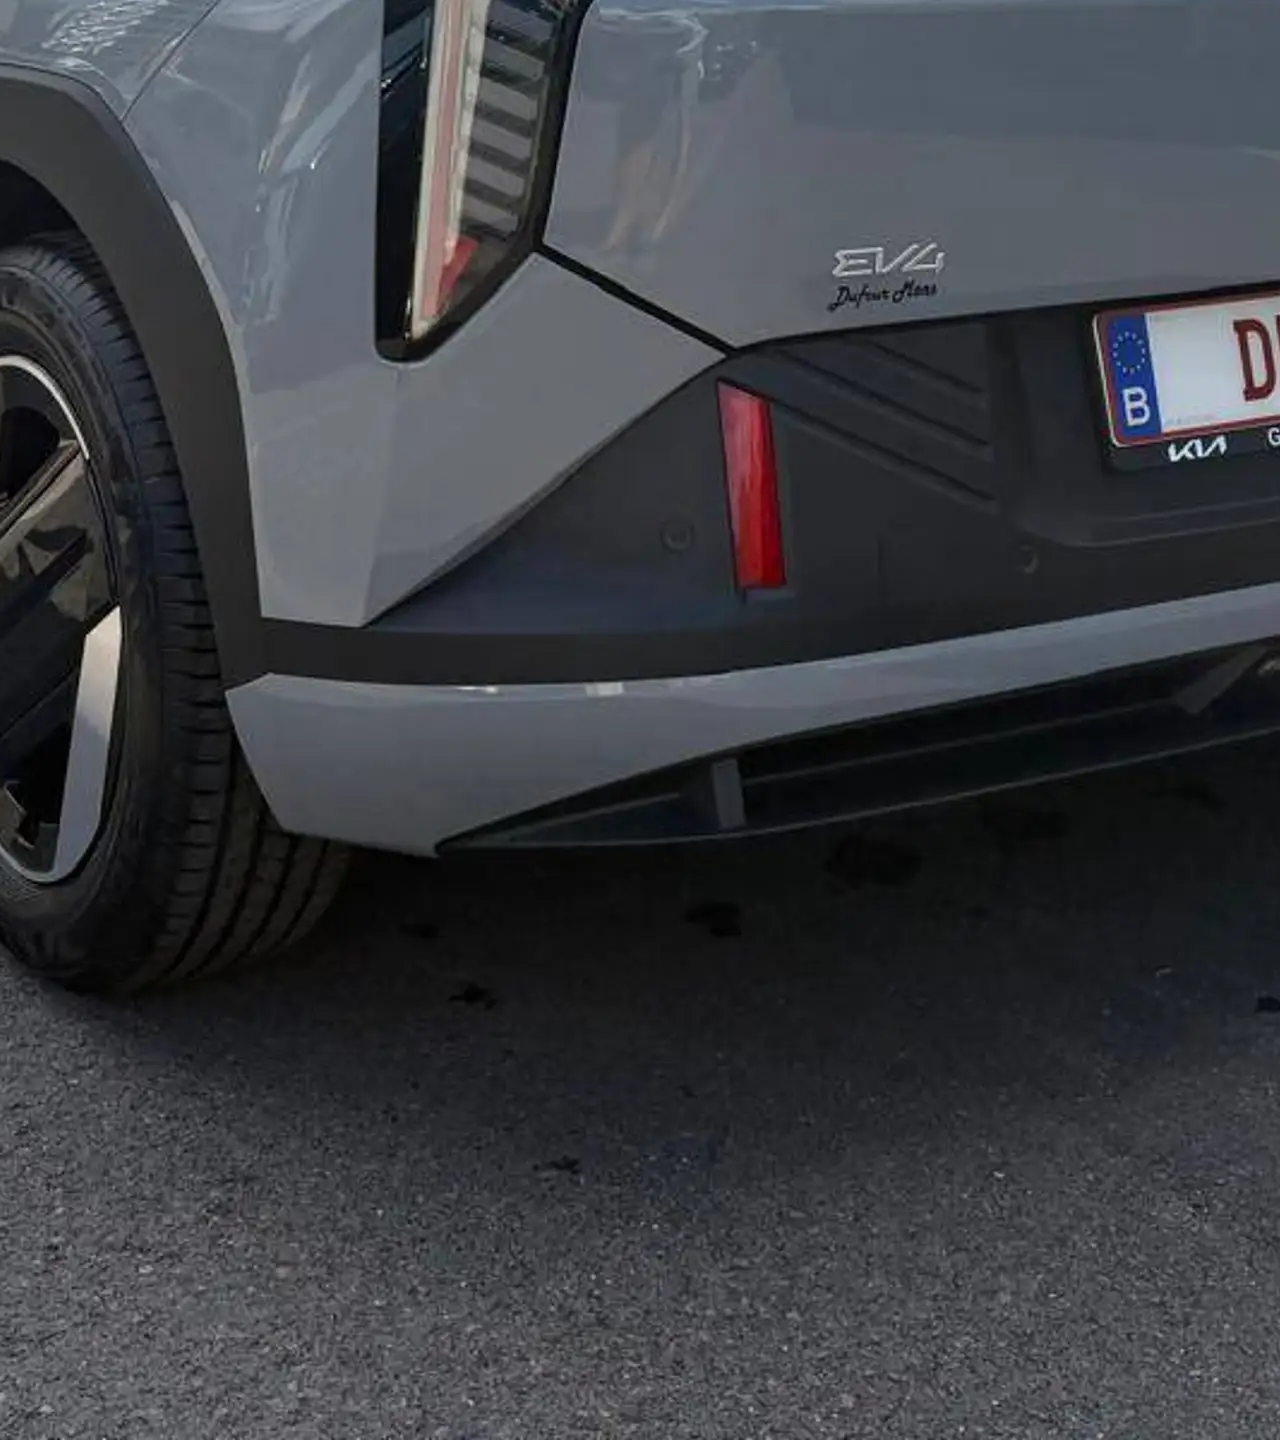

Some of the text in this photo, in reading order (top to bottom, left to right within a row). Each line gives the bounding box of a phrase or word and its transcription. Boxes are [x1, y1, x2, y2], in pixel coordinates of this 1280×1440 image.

[832, 243, 946, 277] EV4
[1122, 386, 1151, 426] B
[1168, 435, 1227, 462] KIA
